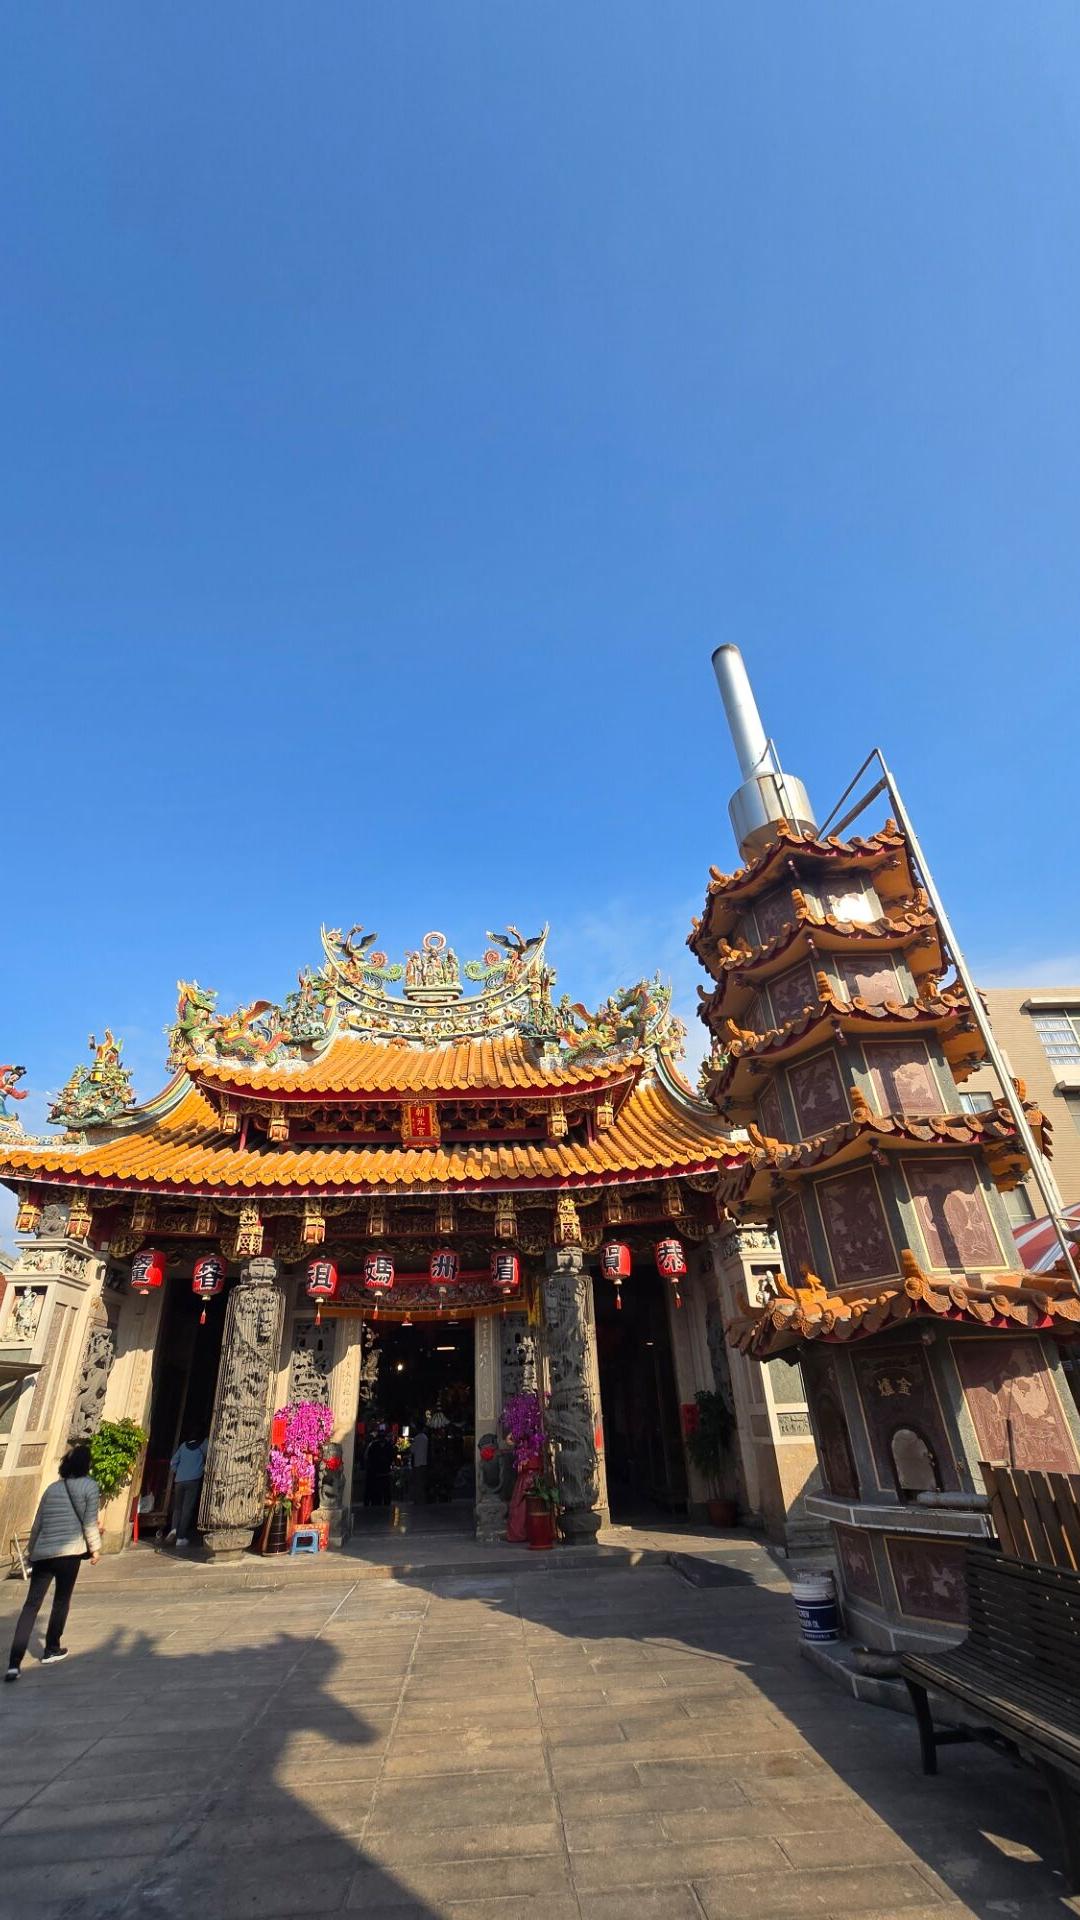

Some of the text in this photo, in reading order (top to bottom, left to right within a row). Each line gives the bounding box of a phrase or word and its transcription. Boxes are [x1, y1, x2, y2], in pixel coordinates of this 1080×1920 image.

[415, 1108, 426, 1136] 朝元宮
[364, 1255, 393, 1284] 媽
[431, 1254, 458, 1280] 洲
[657, 1242, 688, 1271] 恭
[307, 1263, 333, 1289] 祖
